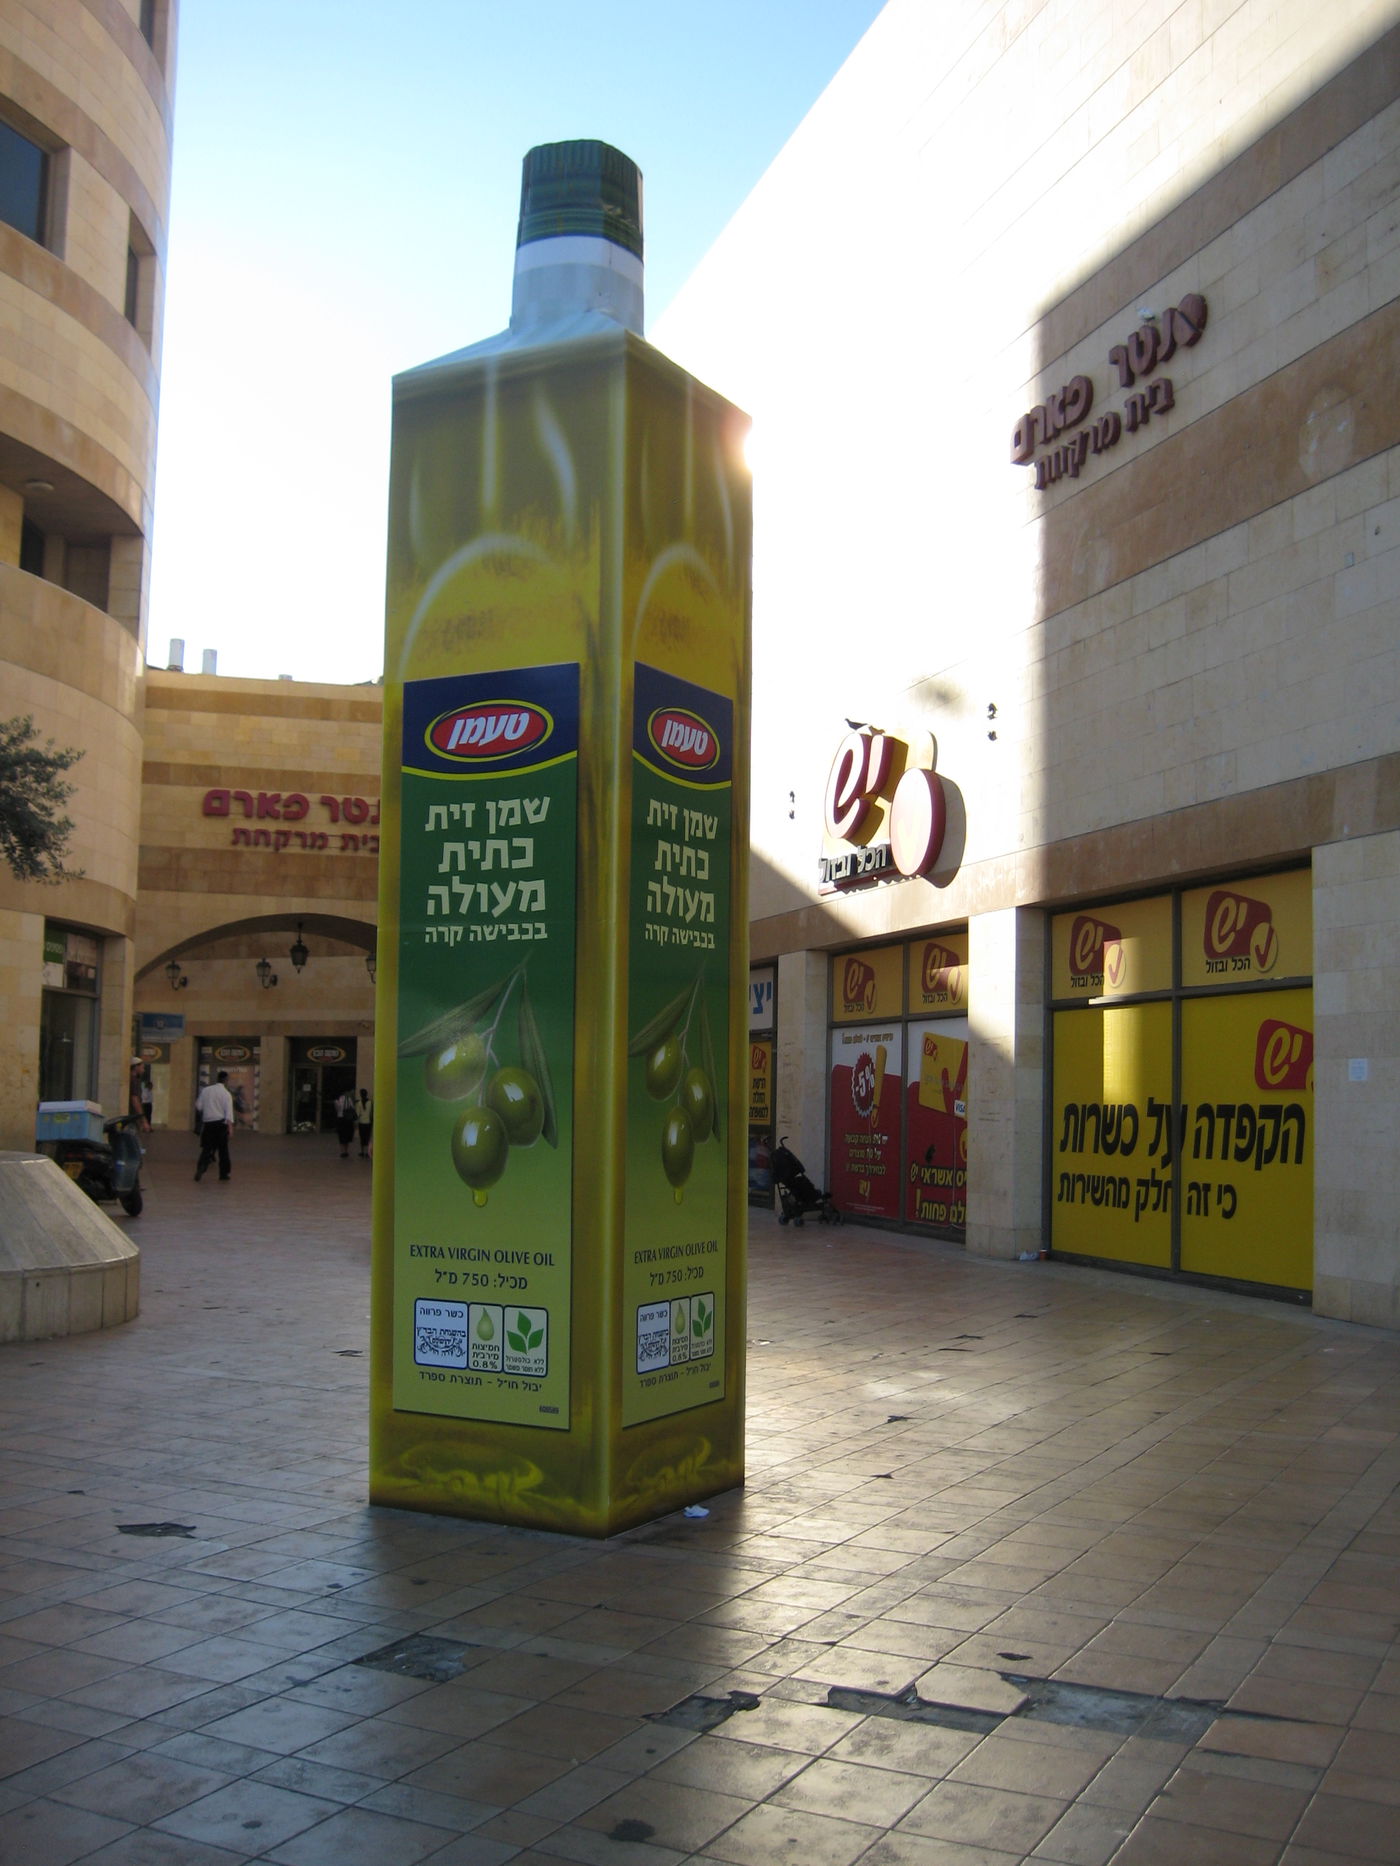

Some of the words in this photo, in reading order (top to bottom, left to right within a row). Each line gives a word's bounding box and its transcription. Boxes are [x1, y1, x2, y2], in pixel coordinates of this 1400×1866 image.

[1124, 378, 1176, 432] בית
[1010, 375, 1094, 466] פארם
[1034, 411, 1122, 490] מרקחת
[446, 712, 531, 750] טעמן
[661, 719, 709, 756] טעמן
[203, 789, 310, 821] פארם
[425, 803, 476, 832] זית
[486, 796, 551, 834] שמן
[647, 799, 678, 831] זית
[231, 827, 330, 853] מרקחת
[683, 808, 719, 842] שמן
[340, 833, 380, 853] בית
[438, 837, 534, 873] כתית
[655, 839, 710, 881] כתית
[818, 853, 856, 883] ובזול
[856, 844, 889, 875] הכל
[427, 875, 546, 918] מעולה
[646, 875, 715, 923] מעולה
[425, 926, 463, 947] קרה
[469, 922, 548, 942] בכבישה
[645, 923, 669, 946] קרה
[672, 928, 716, 949] בכבישה
[1211, 897, 1248, 953] יש
[1075, 921, 1104, 970] יש
[1205, 959, 1228, 974] ובזול
[1231, 957, 1250, 971] הכל
[1070, 975, 1088, 988] ובזול
[1263, 1027, 1304, 1085] יש
[855, 1064, 875, 1097] -5%
[1059, 1103, 1139, 1156] כשרות
[1147, 1097, 1188, 1169] על
[1193, 1103, 1306, 1171] הקפדה
[921, 1166, 953, 1186] אשראי
[1058, 1172, 1131, 1209] מהשירות
[1134, 1168, 1174, 1222] חלק
[1187, 1182, 1211, 1217] זה
[1216, 1183, 1237, 1219] כי
[410, 1245, 445, 1259] EXTRA
[448, 1247, 490, 1262] VIRGIN
[494, 1250, 530, 1264] OLIVE
[533, 1252, 555, 1266] OIL
[634, 1250, 657, 1264] EXTRA
[658, 1245, 684, 1261] VIRGIN
[686, 1242, 705, 1257] OLIVE
[707, 1240, 718, 1253] OIL
[463, 1272, 489, 1287] 750
[493, 1273, 528, 1290] מכיל:
[666, 1270, 683, 1283] 750
[419, 1307, 442, 1317] פרווה
[445, 1309, 464, 1319] כשר
[472, 1343, 500, 1352] חמיצות
[472, 1351, 499, 1361] מירבית
[419, 1371, 446, 1381] ספרד
[472, 1360, 498, 1370] 0.8%
[450, 1375, 482, 1386] תוצרת
[523, 1381, 542, 1392] יבול
